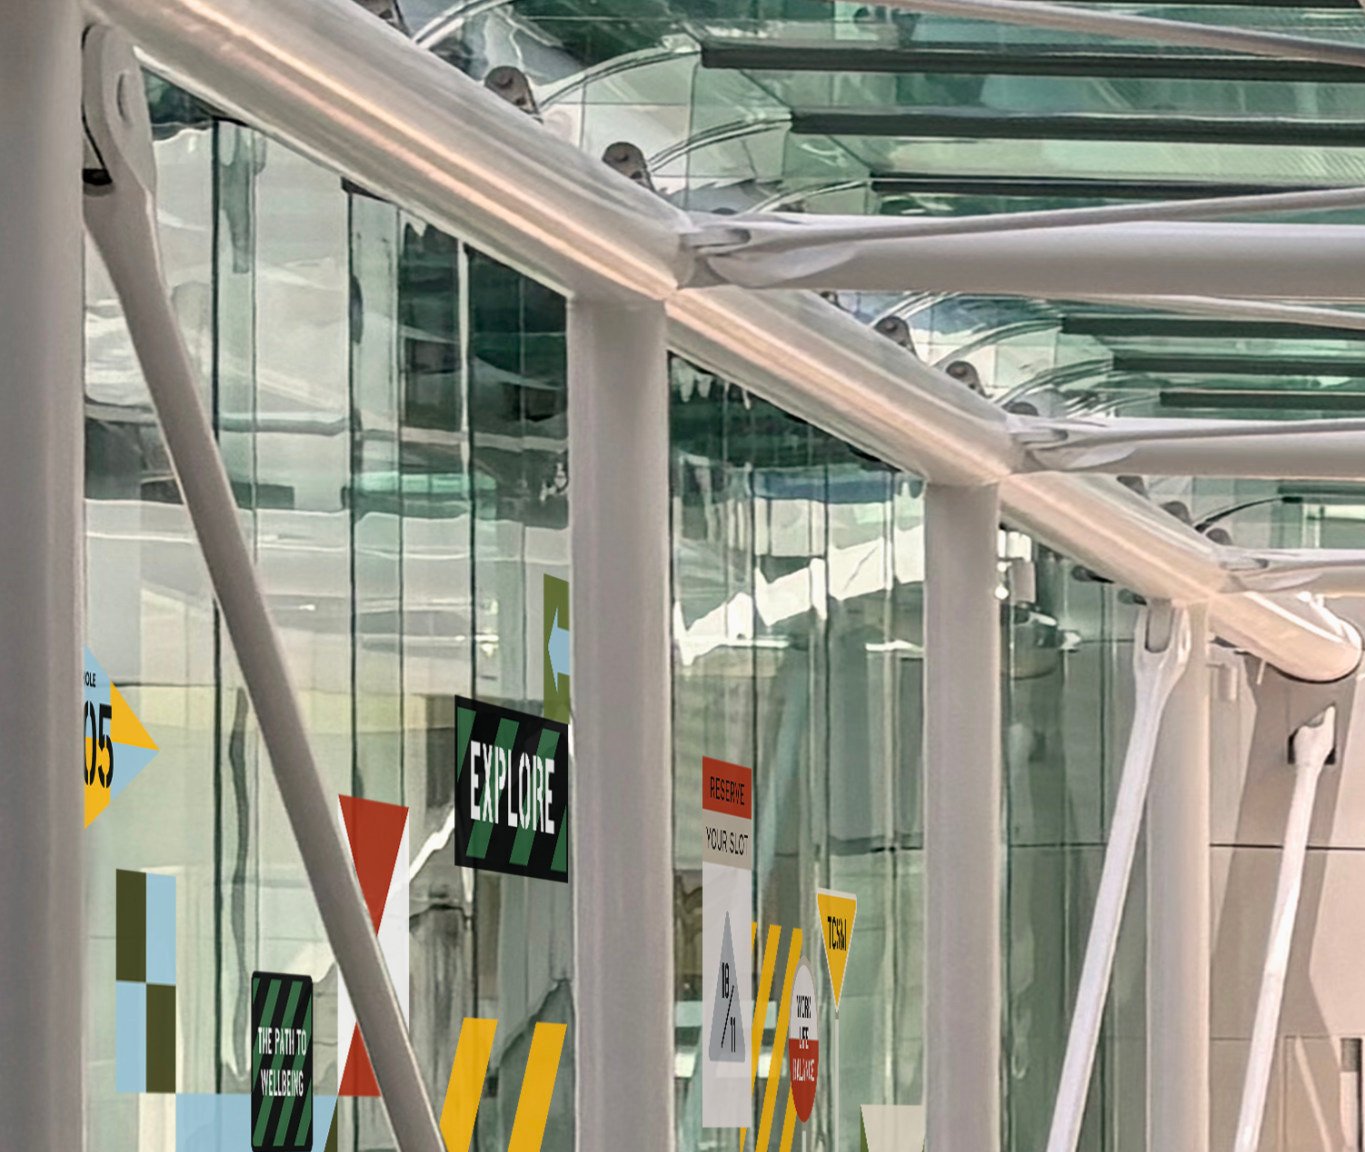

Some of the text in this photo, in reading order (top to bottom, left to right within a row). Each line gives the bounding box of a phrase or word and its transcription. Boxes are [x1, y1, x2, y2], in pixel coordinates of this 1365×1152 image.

[84, 671, 96, 688] OLE
[84, 700, 114, 789] 05
[470, 740, 555, 835] EXPLORE
[710, 776, 745, 806] RESERVE
[706, 826, 748, 857] YOUR SLOT
[258, 1027, 307, 1056] THE PATH TO
[261, 1069, 304, 1097] WELLBEING
